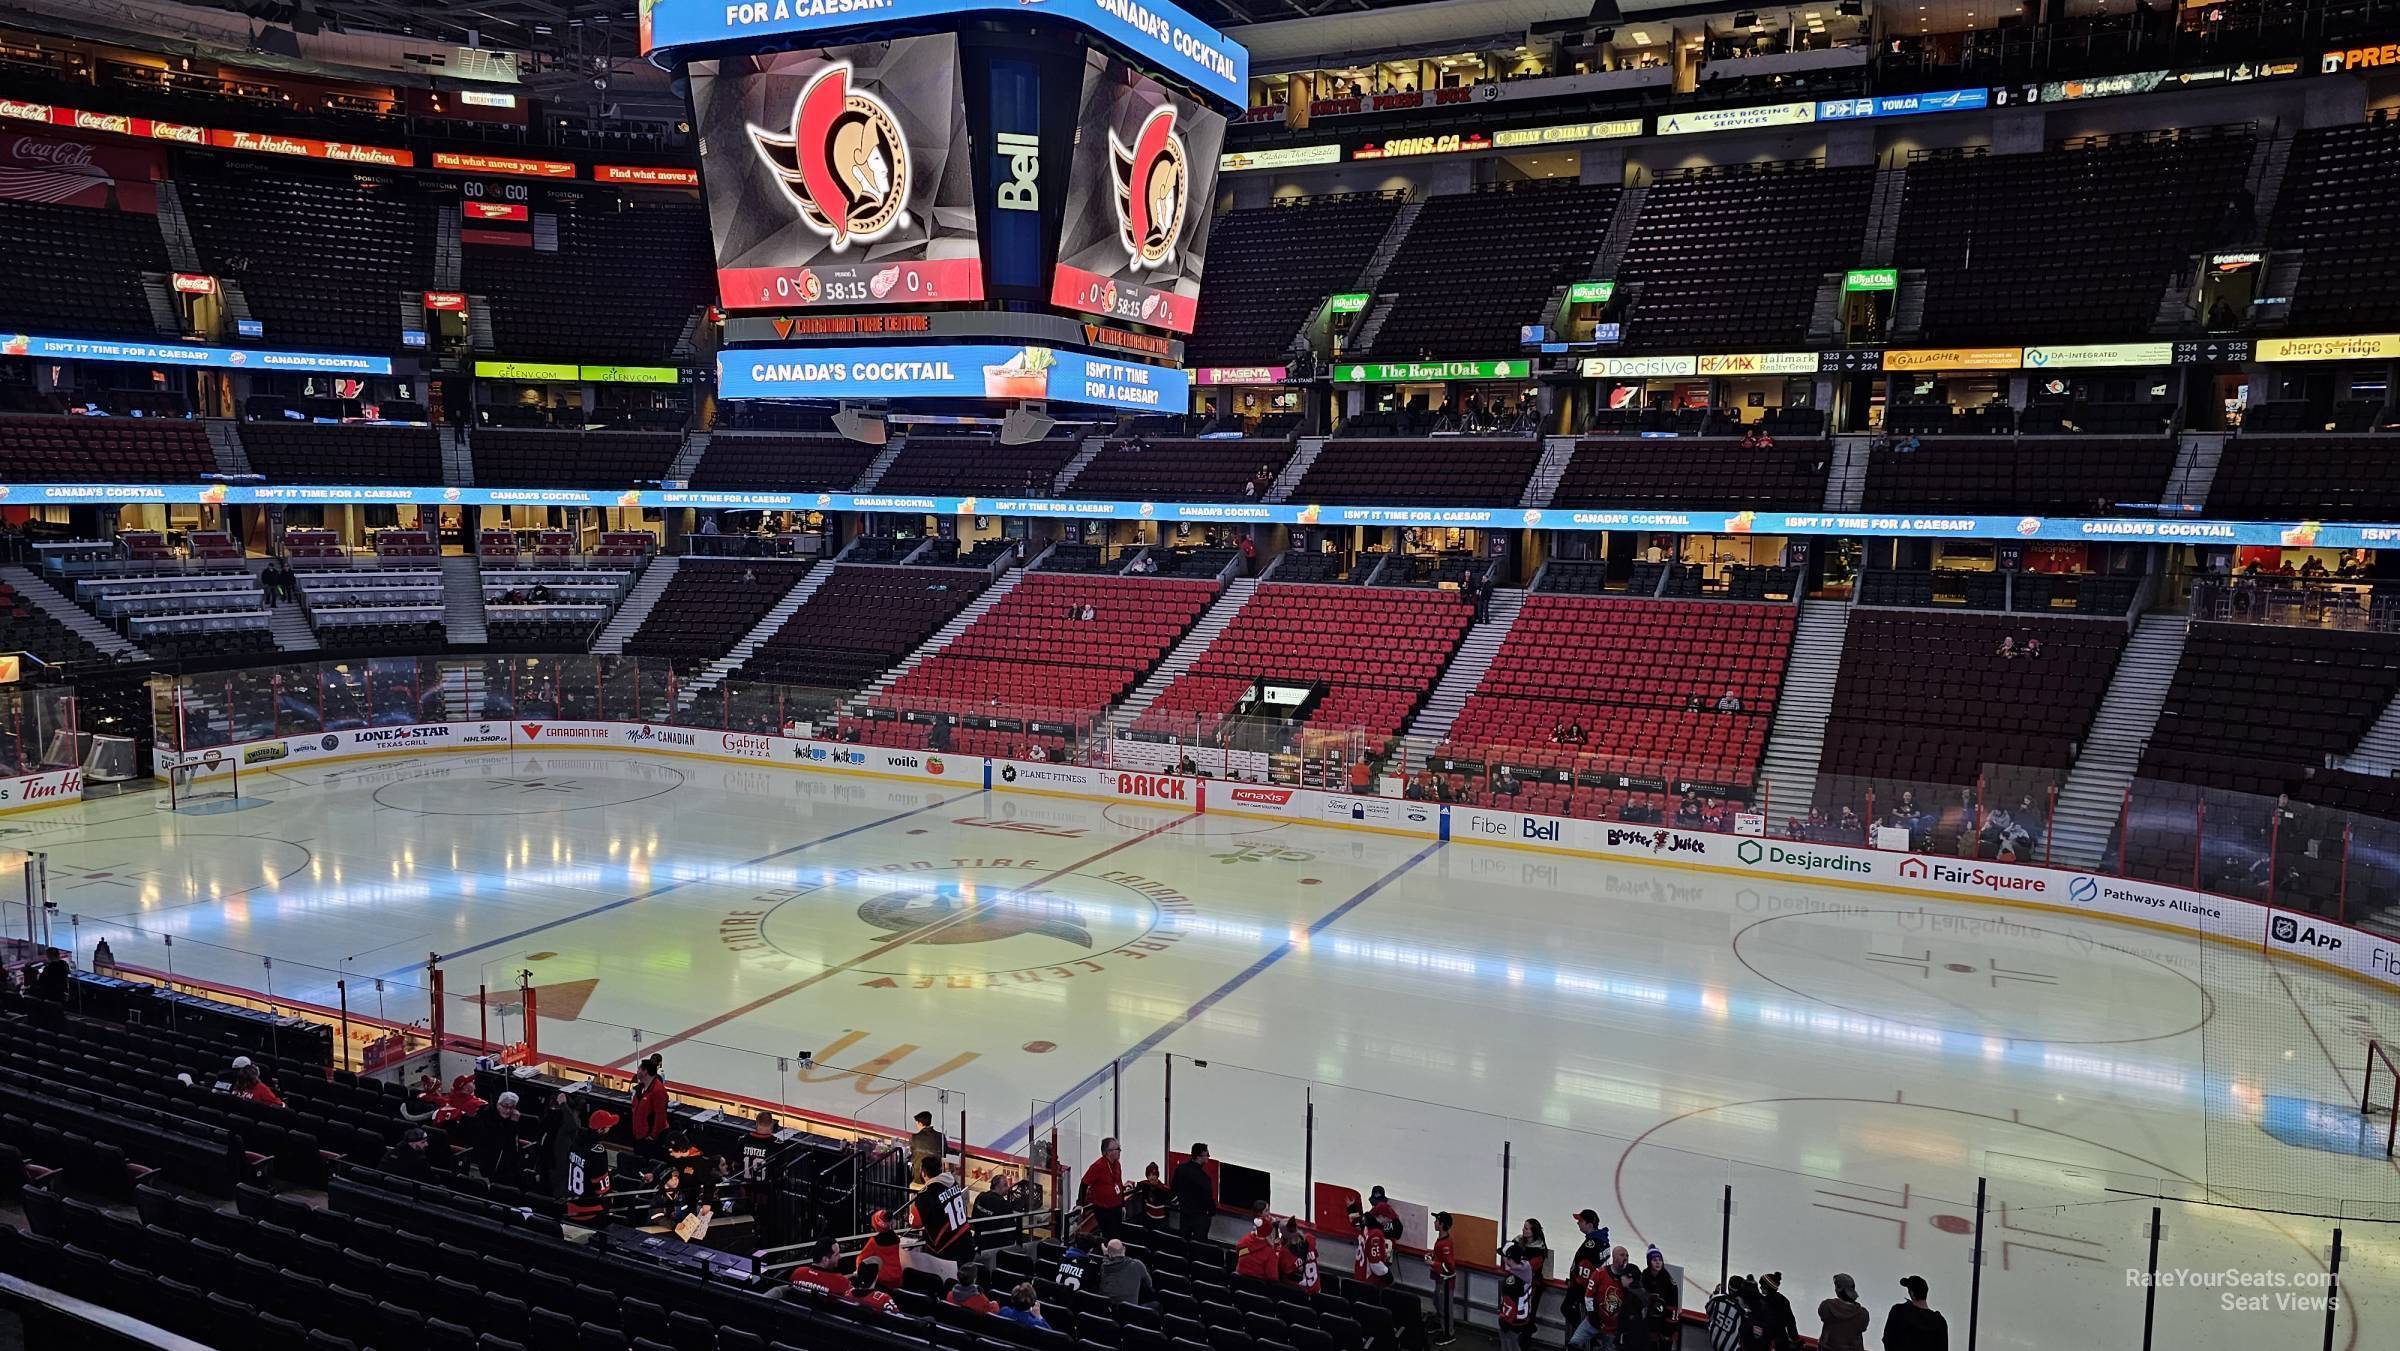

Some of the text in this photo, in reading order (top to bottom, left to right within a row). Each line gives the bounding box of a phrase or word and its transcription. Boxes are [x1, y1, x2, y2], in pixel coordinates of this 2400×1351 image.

[727, 0, 790, 26] FOR A
[1173, 28, 1237, 83] COCKTAIL
[1484, 88, 1495, 97] 18
[2026, 88, 2038, 103] 0
[2096, 79, 2132, 94] skate
[1881, 97, 1919, 111] YOW.CA
[1996, 90, 2008, 105] 0
[1694, 107, 1790, 123] ACCESS RIGGING
[1713, 117, 1768, 128] SERVICES
[1495, 121, 1640, 145] COMBAT COMBAT COMBAT
[12, 136, 96, 167] Coca-Cola
[232, 131, 307, 156] Tim Hortons
[1384, 134, 1460, 157] SIGNS.CA
[324, 143, 396, 165] Tim Hortons
[437, 155, 538, 173] Find what moves you
[997, 132, 1040, 211] Bell
[609, 168, 631, 179] Find
[632, 169, 656, 180] what
[657, 172, 687, 182] moves
[464, 182, 528, 200] GO GO!
[776, 276, 789, 297] 0
[907, 271, 920, 292] 0
[825, 282, 868, 300] 58:15
[1116, 297, 1141, 317] 58:15
[44, 342, 209, 361] ISN'T IT TIME FOR A CAESAR?
[1862, 351, 1879, 359] 324
[2051, 351, 2118, 359] DA-INTEGRATED
[2178, 343, 2198, 352] 324
[2227, 342, 2248, 351] 325
[264, 356, 370, 369] CANADA'S COCKTAIL
[1700, 354, 1816, 372] RE/MAX Hallmark
[1823, 352, 1840, 360] 323
[1897, 353, 1960, 365] GALLAGHER
[2177, 354, 2197, 363] 224
[2227, 353, 2248, 361] 225
[752, 362, 954, 382] CANADA'S COCKTAIL
[1085, 361, 1149, 385] ISN'T IT TIME
[1222, 368, 1271, 378] MAGENTA
[1379, 362, 1479, 380] The Royal Oak
[1609, 359, 1687, 376] Decisive
[1759, 362, 1816, 372] Realty Group
[1822, 364, 1839, 372] 223
[1861, 363, 1878, 371] 224
[1085, 381, 1159, 405] FOR A CAESAR?
[45, 487, 1114, 513] CANADA'S COCKTAIL ISN'T IT TIME FOR A CAESAR? CANADA'S COCKTAIL ISN'T TIME FOR CAESAR? CANADA'S ISN'T TIME CAESAR?
[355, 725, 450, 743] LONE STAR
[546, 728, 609, 739] CANADIAN TIRE
[657, 730, 695, 746] CANADIAN
[722, 733, 770, 751] Gabriel
[376, 739, 428, 749] TEXAS GRILL
[736, 749, 771, 758] PIZZA
[888, 755, 919, 768] voilà
[1020, 769, 1087, 784] PLANET FITNESS
[20, 779, 58, 800] Tim
[1099, 772, 1186, 800] The BRICK
[1327, 799, 1348, 810] Ford
[1472, 815, 1560, 842] Fibe Bell
[1607, 828, 1706, 854] Booster Juice
[1770, 847, 1872, 874] Desjardins
[1934, 865, 2047, 893] FairSquare
[2103, 887, 2222, 919] Pathways Alliance
[568, 1162, 585, 1196] 18
[944, 1195, 967, 1231] 18
[1578, 1265, 1591, 1279] 19
[1715, 1312, 1734, 1332] 59
